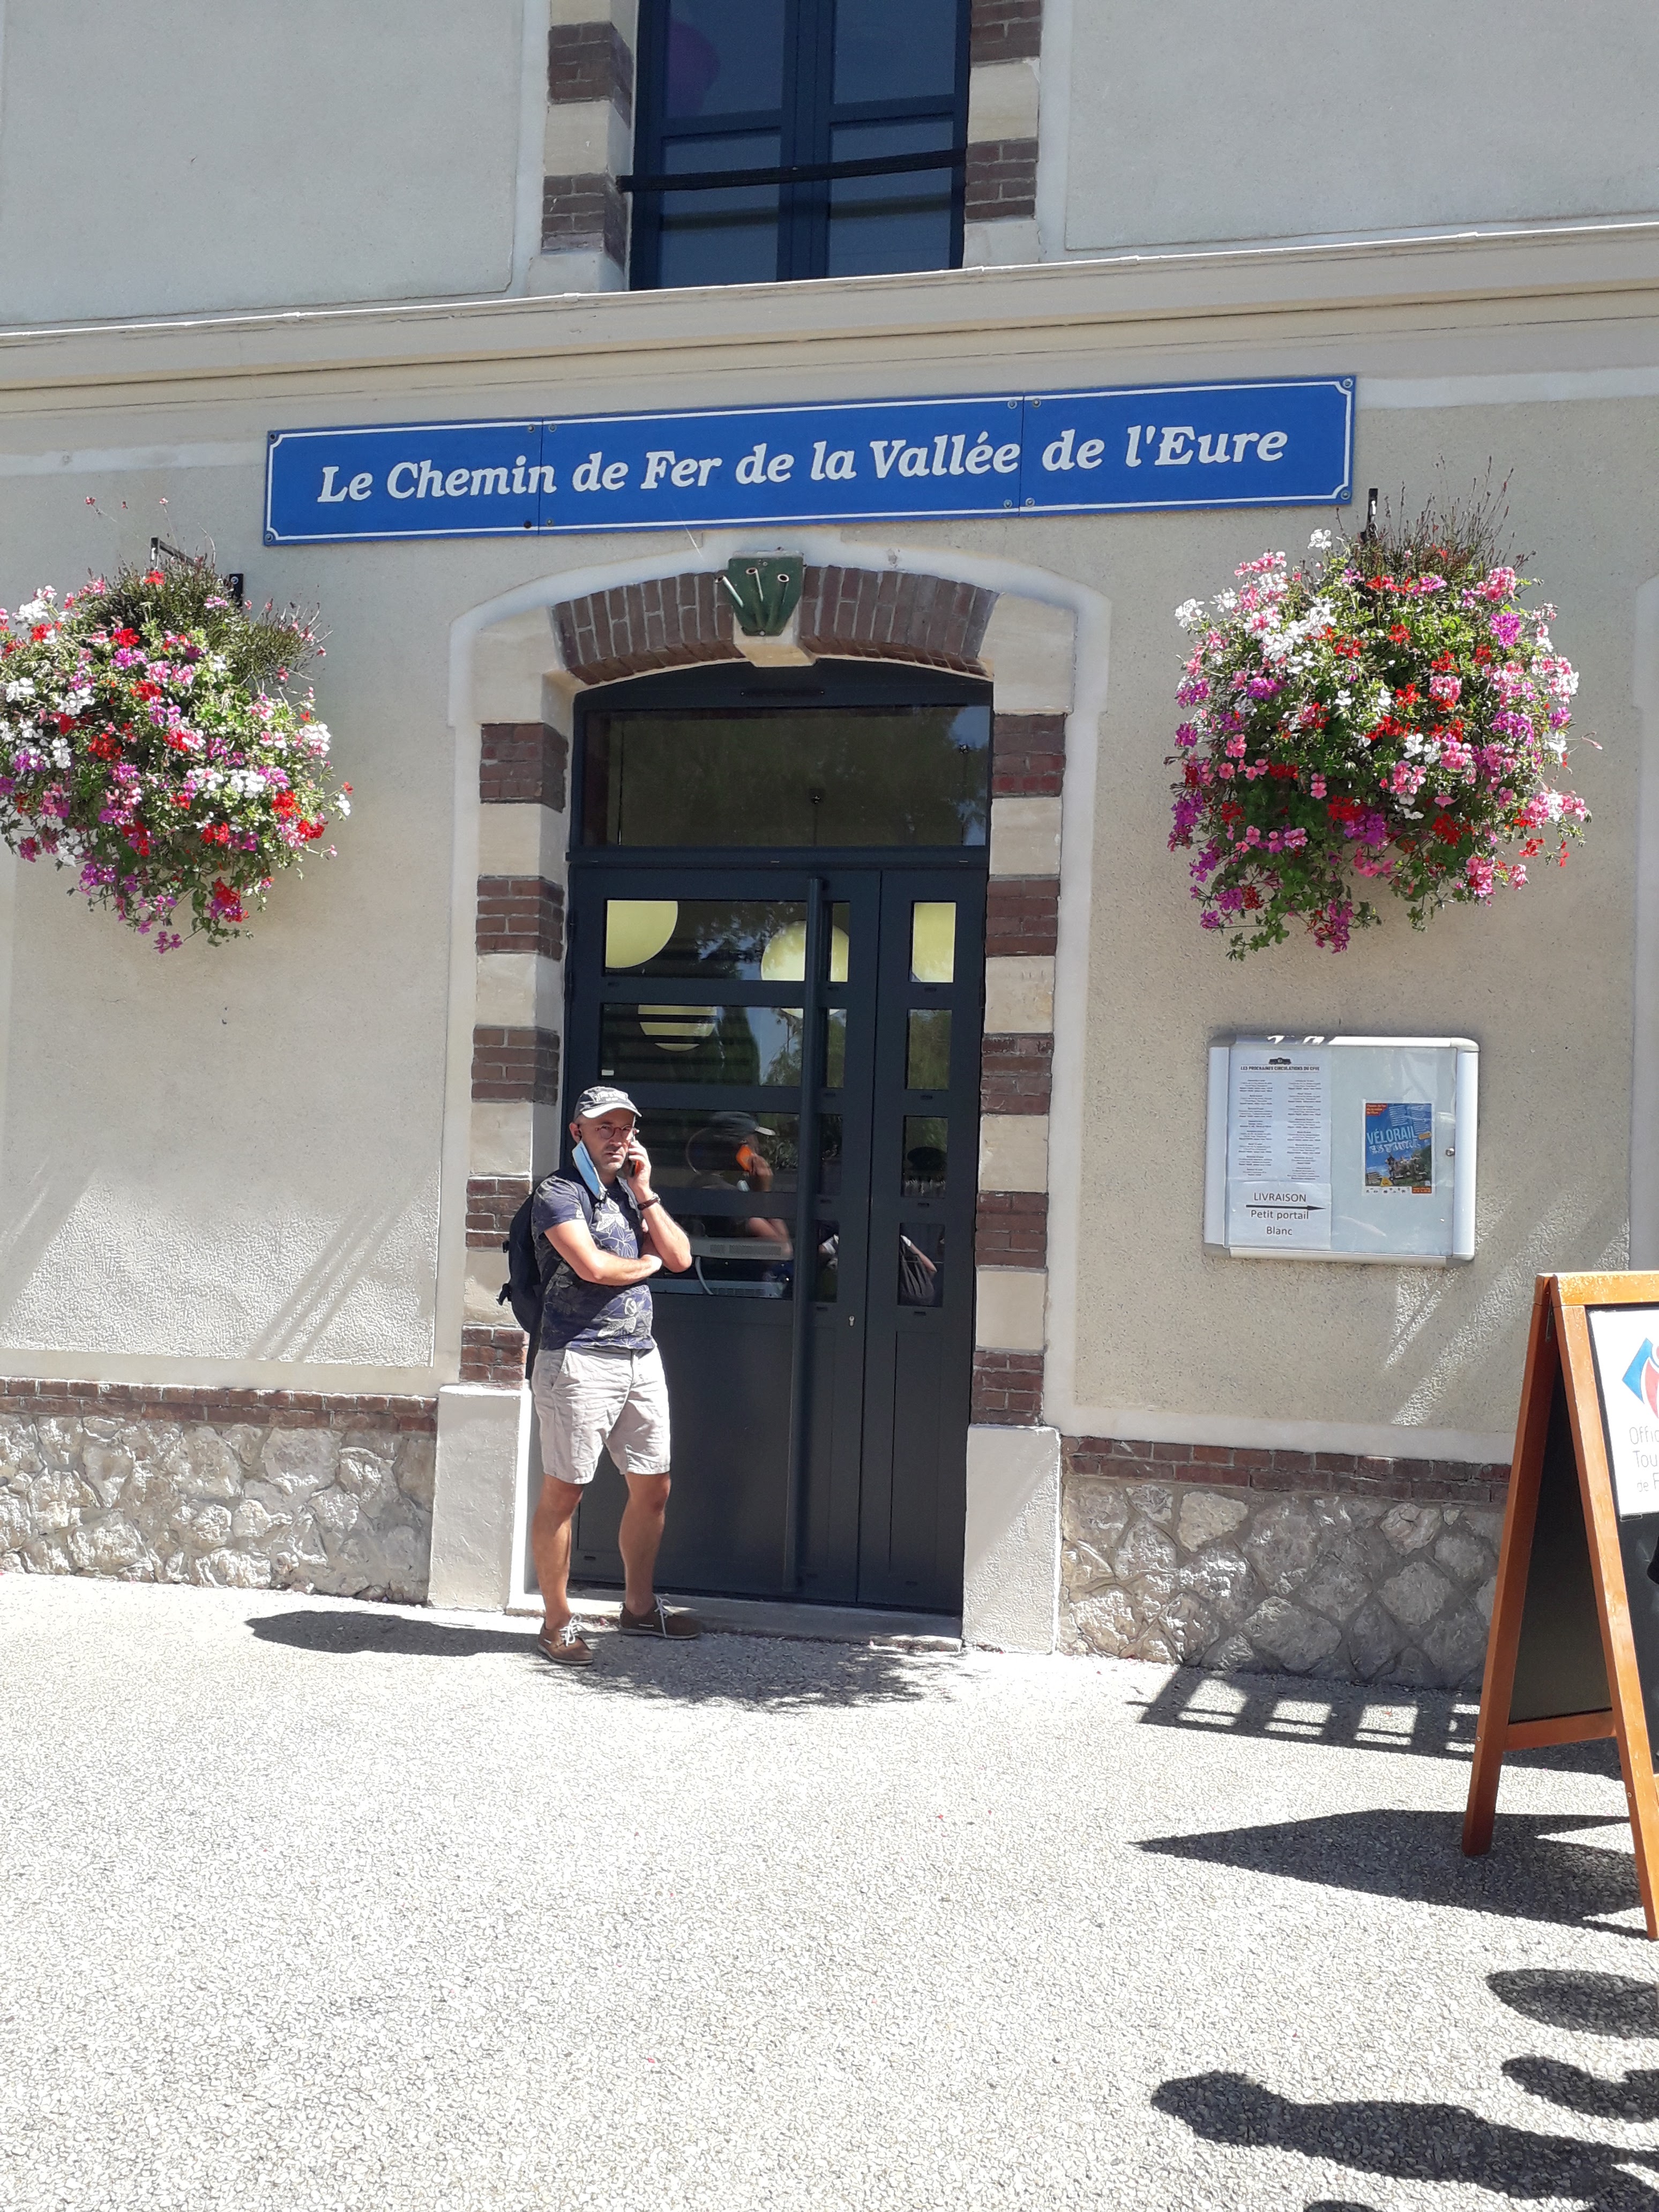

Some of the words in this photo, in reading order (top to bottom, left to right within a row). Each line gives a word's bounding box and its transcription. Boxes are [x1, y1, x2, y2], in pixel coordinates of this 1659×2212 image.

[317, 466, 372, 502] Le
[387, 455, 557, 501] Chemin
[572, 451, 629, 492] de
[640, 451, 722, 489] Fer
[736, 443, 794, 484] de
[810, 440, 857, 481] la
[869, 431, 1020, 479] Vallée
[1042, 429, 1105, 471] de
[1125, 425, 1288, 467] l'Eure
[1366, 1125, 1418, 1145] VÉLORAIL
[1253, 1192, 1306, 1202] LIVRAISON
[1251, 1209, 1274, 1219] Petit
[1277, 1210, 1309, 1221] portail
[1266, 1225, 1292, 1235] Blanc
[1637, 1479, 1649, 1492] de
